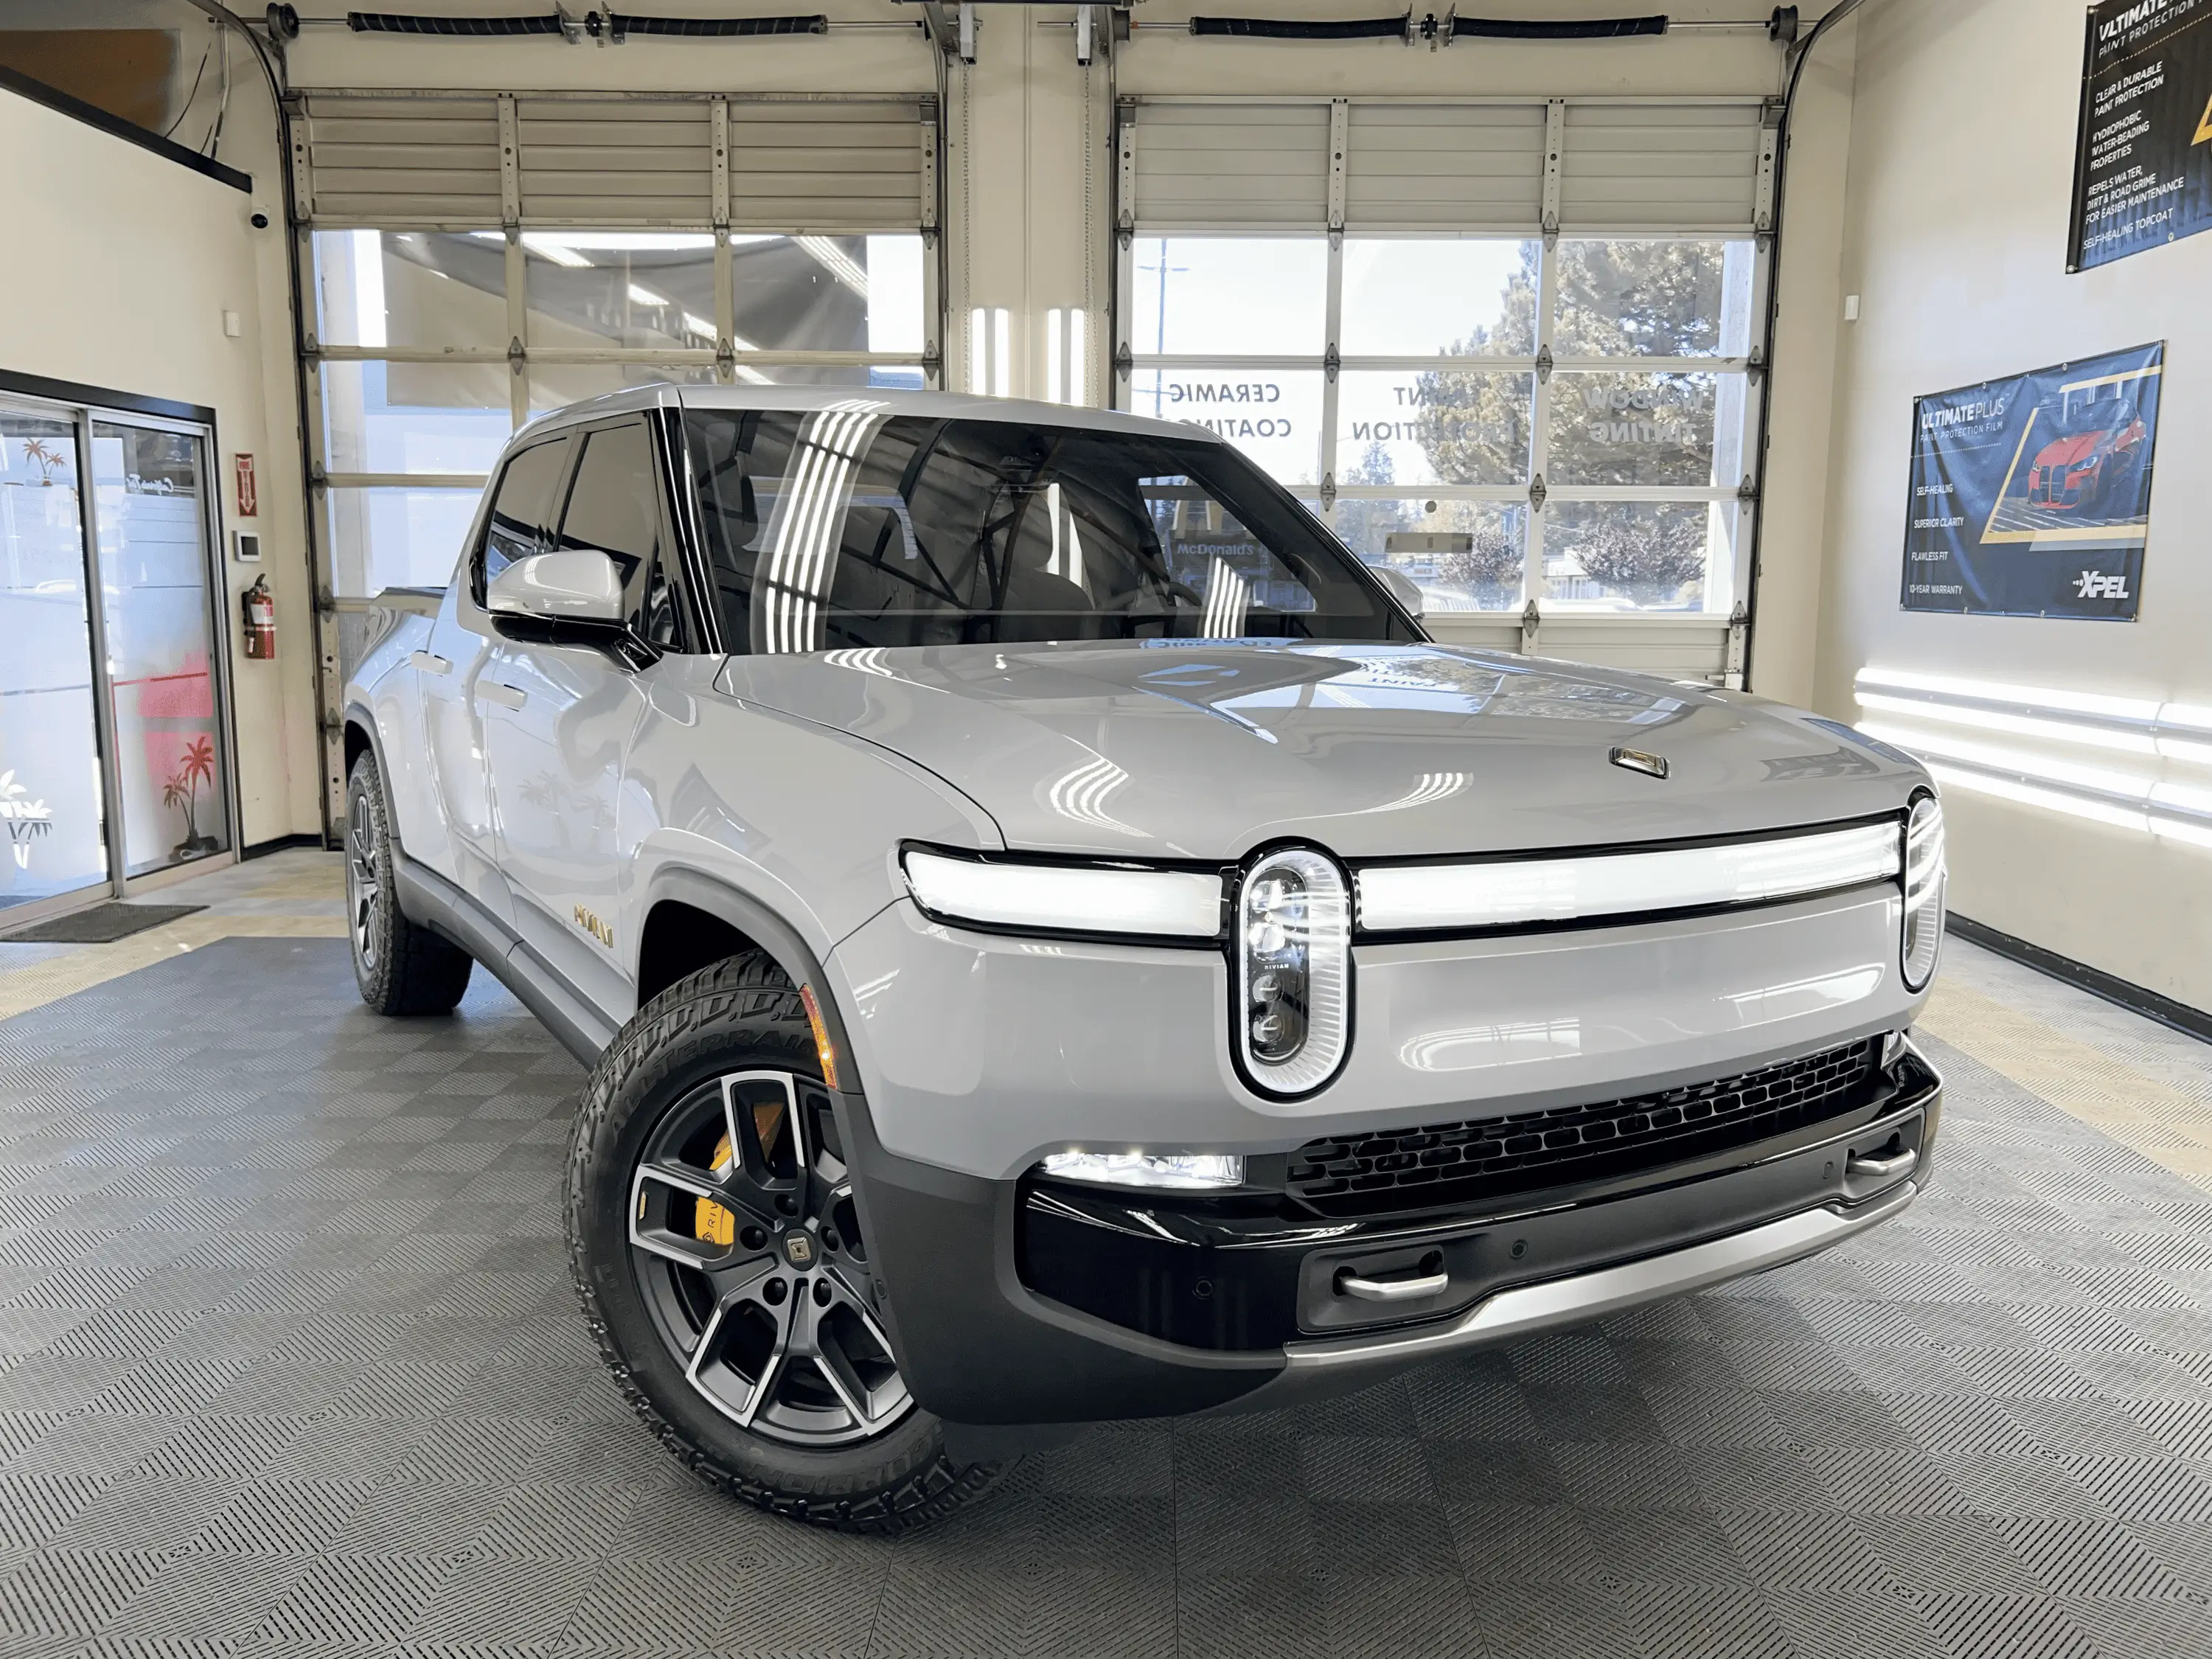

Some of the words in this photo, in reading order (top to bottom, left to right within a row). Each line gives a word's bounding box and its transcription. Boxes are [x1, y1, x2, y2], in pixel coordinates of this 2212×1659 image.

[2098, 35, 2126, 59] PAINT
[2129, 0, 2194, 42] PROTECTION
[2094, 99, 2114, 118] PAINT
[2115, 74, 2164, 107] PROTECTION
[2096, 83, 2116, 103] CLEAR
[2117, 80, 2122, 91] &
[2123, 60, 2163, 88] DURABLE
[2092, 120, 2149, 156] WATER-BEADING
[2093, 110, 2141, 143] HYDROPHOBIC
[2090, 144, 2132, 171] PROPERTIES
[2087, 195, 2103, 211] DIRT
[2104, 193, 2109, 204] &
[2110, 184, 2131, 201] ROAD
[2132, 173, 2156, 192] GRIME
[2088, 178, 2113, 197] REPELS
[2114, 165, 2143, 184] WATER,
[2085, 211, 2100, 225] FOR
[2101, 200, 2126, 219] EASIER
[2128, 176, 2184, 208] MAINTENANCE
[2083, 223, 2134, 249] SELF-HEALING
[2135, 208, 2173, 231] TOPCOAT
[1941, 424, 1983, 439] PROTECTION
[1986, 421, 2003, 432] FILM
[1916, 483, 1953, 496] SELF-HEALING
[1914, 518, 1939, 529] SUPERIOR
[1940, 517, 1964, 528] CLARITY
[1178, 543, 1253, 555] McDonald's
[1911, 552, 1938, 561] FLAWLESS
[1939, 551, 1948, 561] FIT
[1909, 584, 1930, 594] 10-YEAR
[1930, 585, 1963, 595] WARRANTY
[2077, 571, 2129, 599] XPEL
